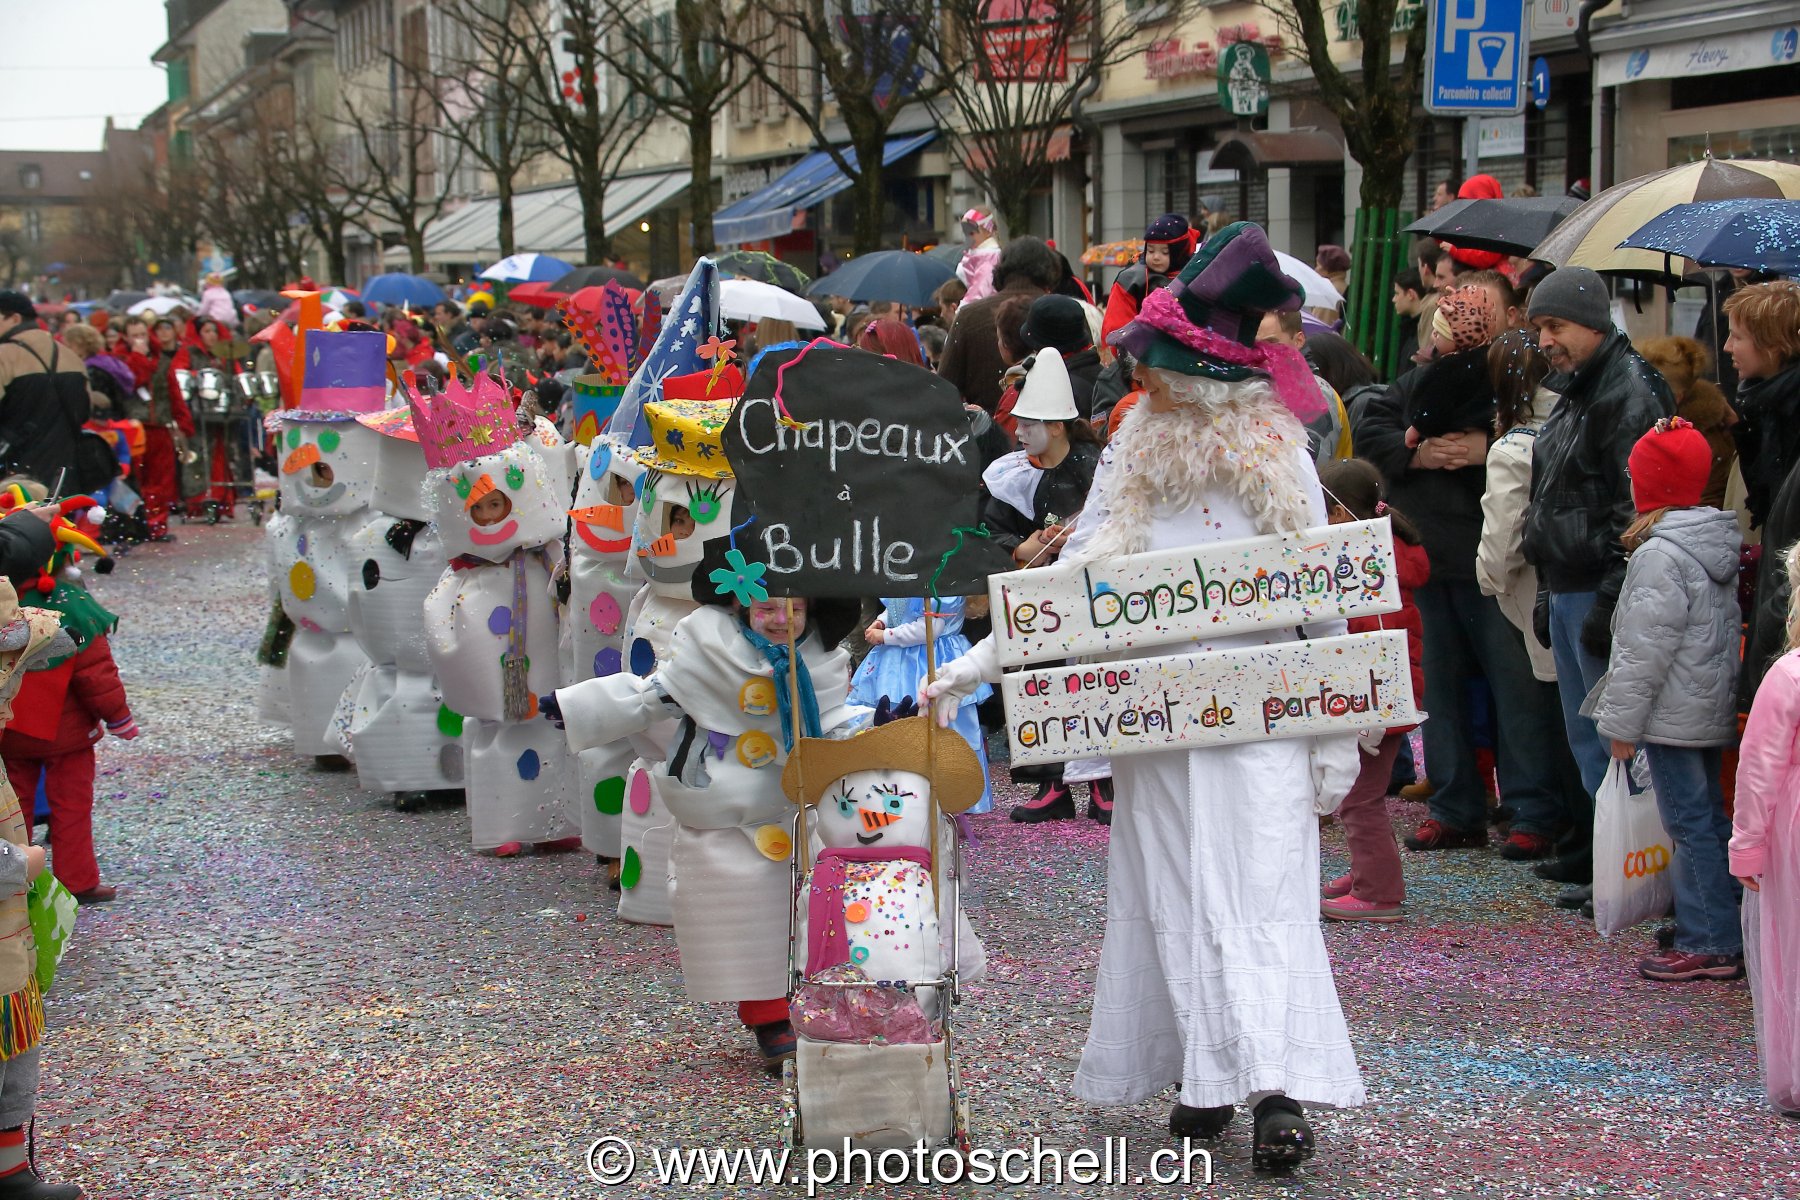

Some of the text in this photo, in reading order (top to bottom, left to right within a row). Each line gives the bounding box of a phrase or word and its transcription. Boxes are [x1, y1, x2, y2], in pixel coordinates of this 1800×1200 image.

[1443, 0, 1486, 53] P
[1438, 85, 1513, 101] Parcomètre collectif
[1535, 72, 1545, 94] 1
[739, 397, 970, 473] Chapeaux
[759, 515, 919, 582] Bulle
[1001, 555, 1387, 640] les bonshommes
[1016, 668, 1384, 748] arrivent de partout
[1024, 668, 1133, 698] de neige
[1623, 843, 1671, 879] coop
